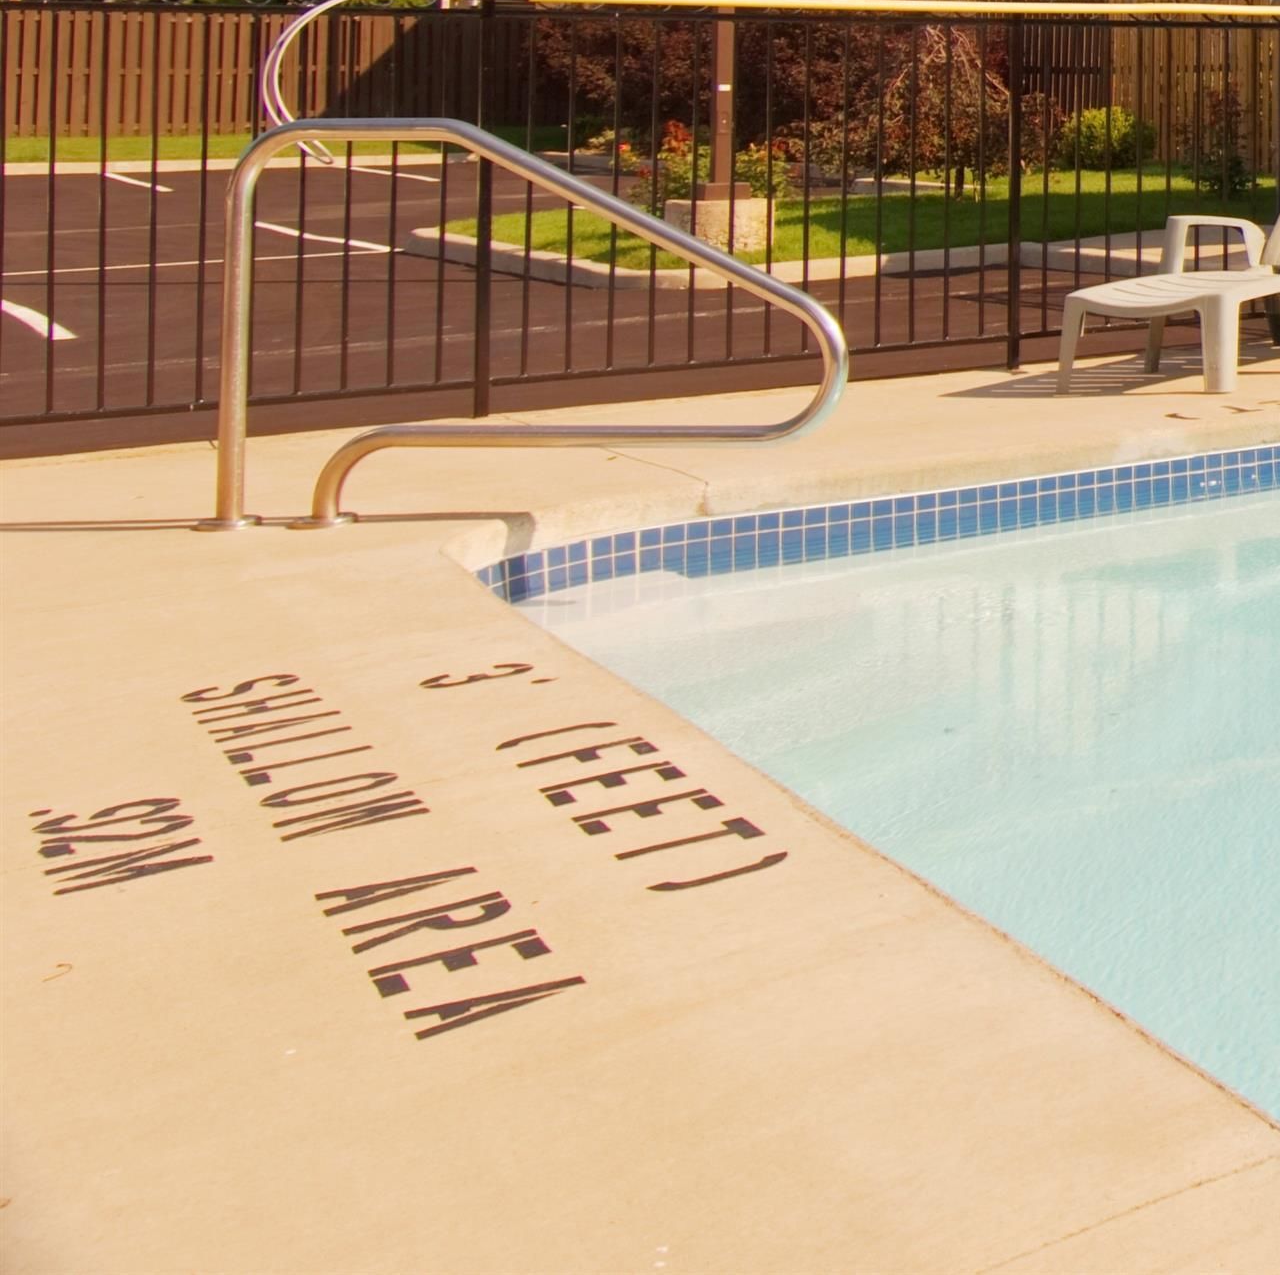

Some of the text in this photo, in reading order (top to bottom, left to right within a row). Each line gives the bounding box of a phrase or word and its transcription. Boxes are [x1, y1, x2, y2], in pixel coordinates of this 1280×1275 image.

[180, 673, 587, 1041] SHALLOW AREA
[495, 721, 788, 892] (FEET)
